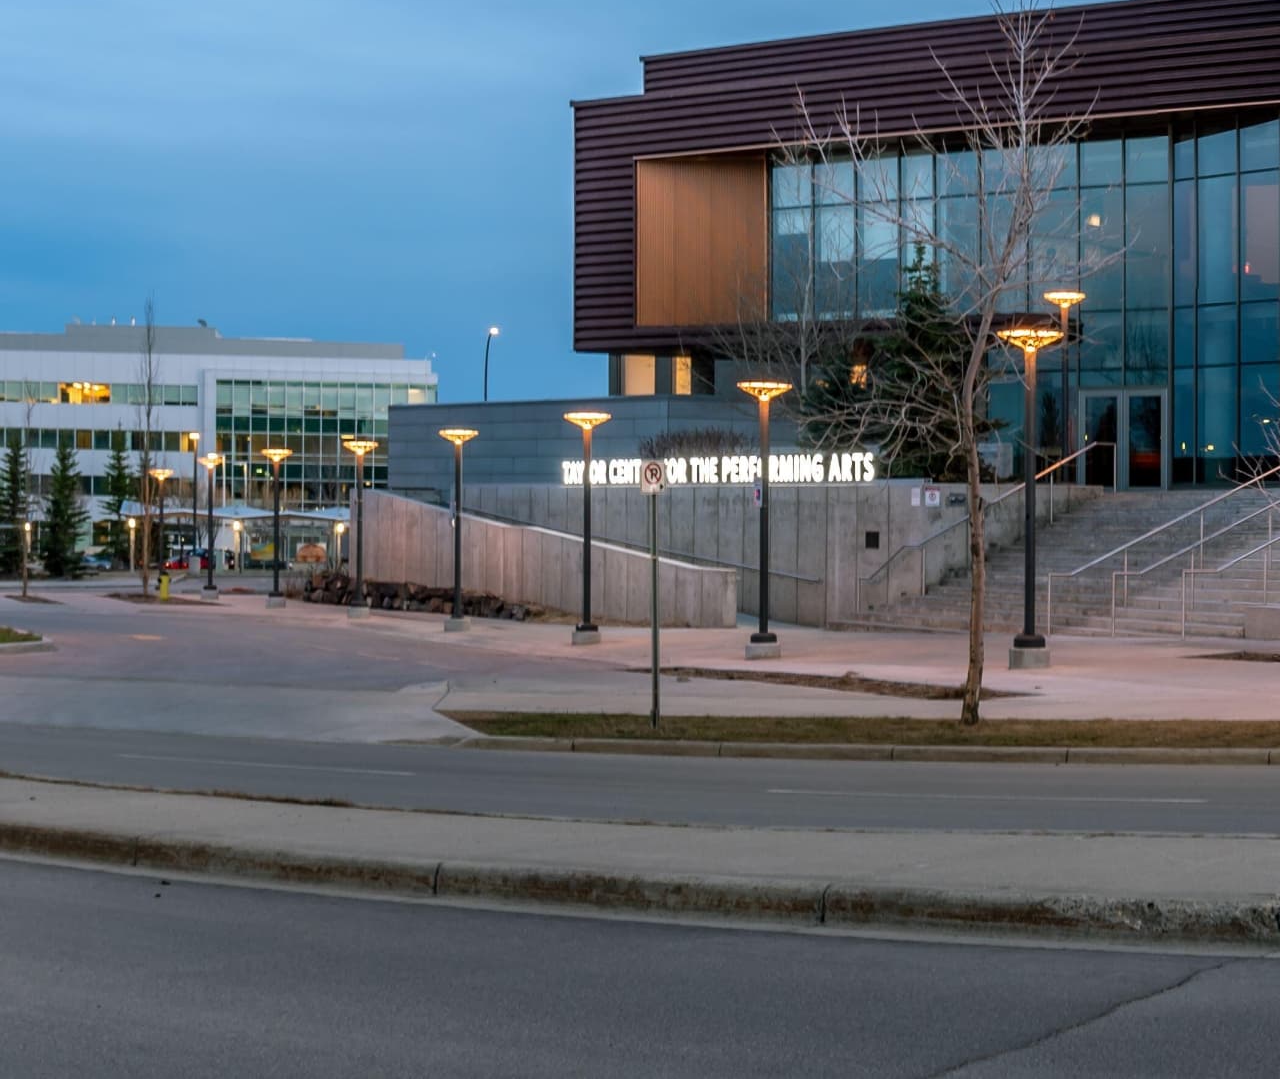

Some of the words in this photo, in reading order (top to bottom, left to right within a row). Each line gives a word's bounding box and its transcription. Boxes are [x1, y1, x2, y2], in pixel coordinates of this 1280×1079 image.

[562, 460, 607, 485] TAYOR
[608, 458, 643, 485] CENT
[665, 458, 687, 484] OR
[690, 457, 719, 483] THE
[828, 452, 875, 482] ARTS
